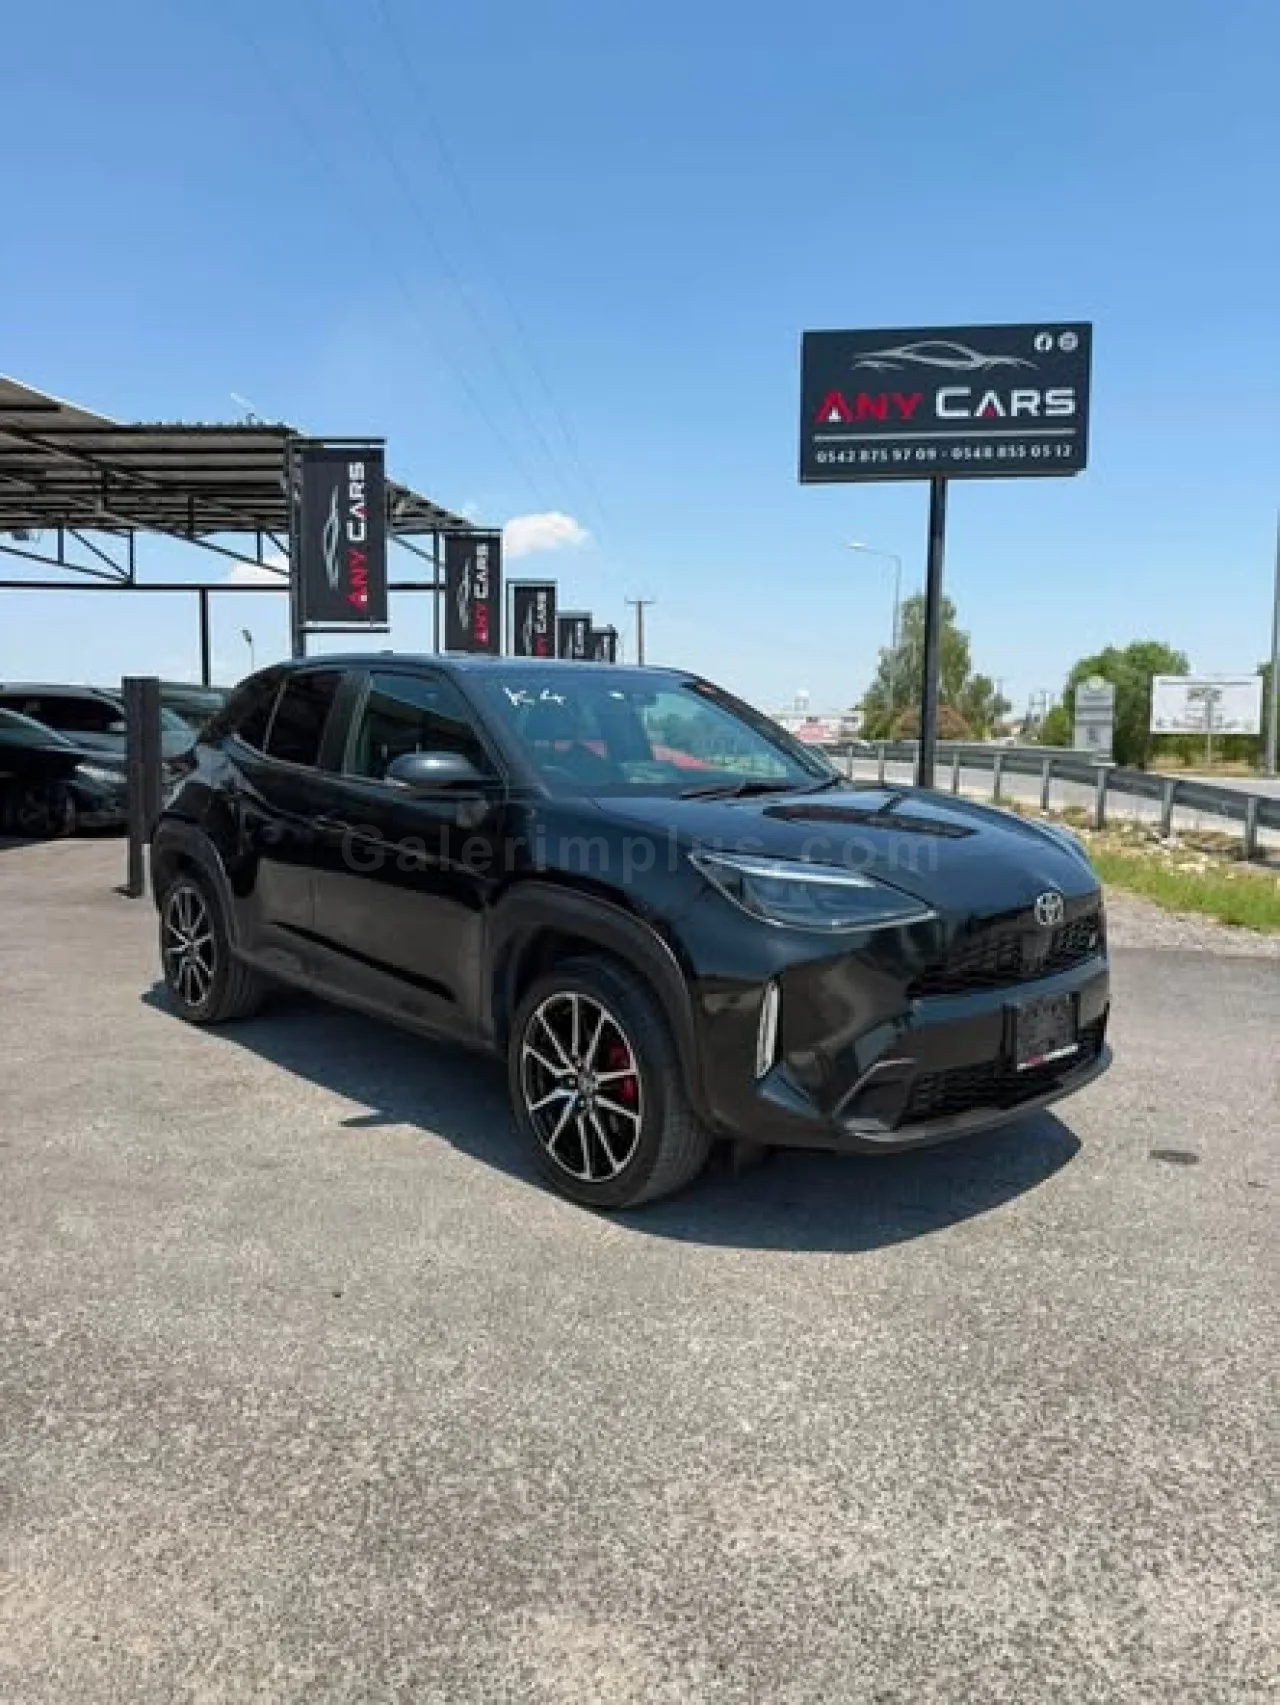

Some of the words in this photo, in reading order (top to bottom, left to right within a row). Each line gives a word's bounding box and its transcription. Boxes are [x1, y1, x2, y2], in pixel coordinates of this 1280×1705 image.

[814, 388, 923, 423] ANY
[936, 386, 1076, 419] CARS
[347, 461, 365, 542] CARS
[346, 549, 368, 612] ANY
